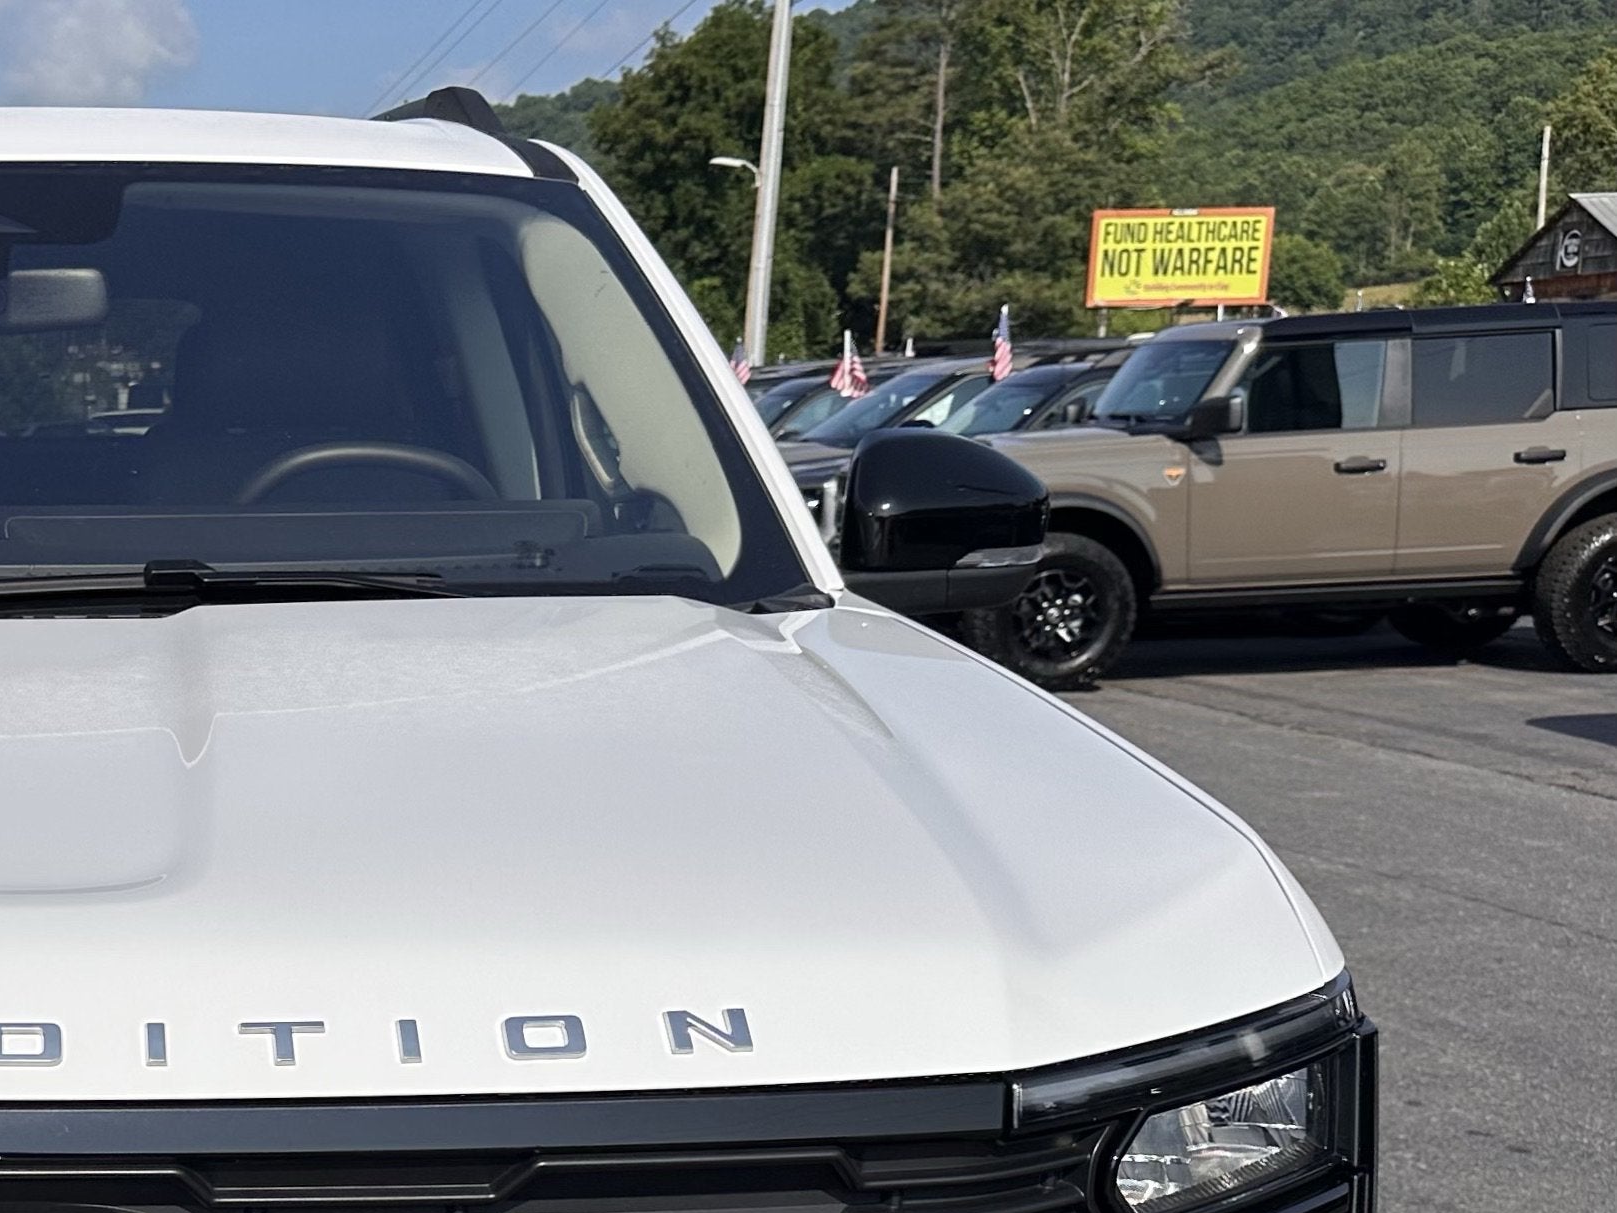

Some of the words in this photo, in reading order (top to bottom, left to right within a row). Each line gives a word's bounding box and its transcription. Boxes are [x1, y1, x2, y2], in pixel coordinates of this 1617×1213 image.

[1103, 221, 1147, 245] FUND
[1152, 219, 1262, 244] HEALTHCARE
[1100, 248, 1146, 278] NOT
[1152, 246, 1259, 277] WARFARE
